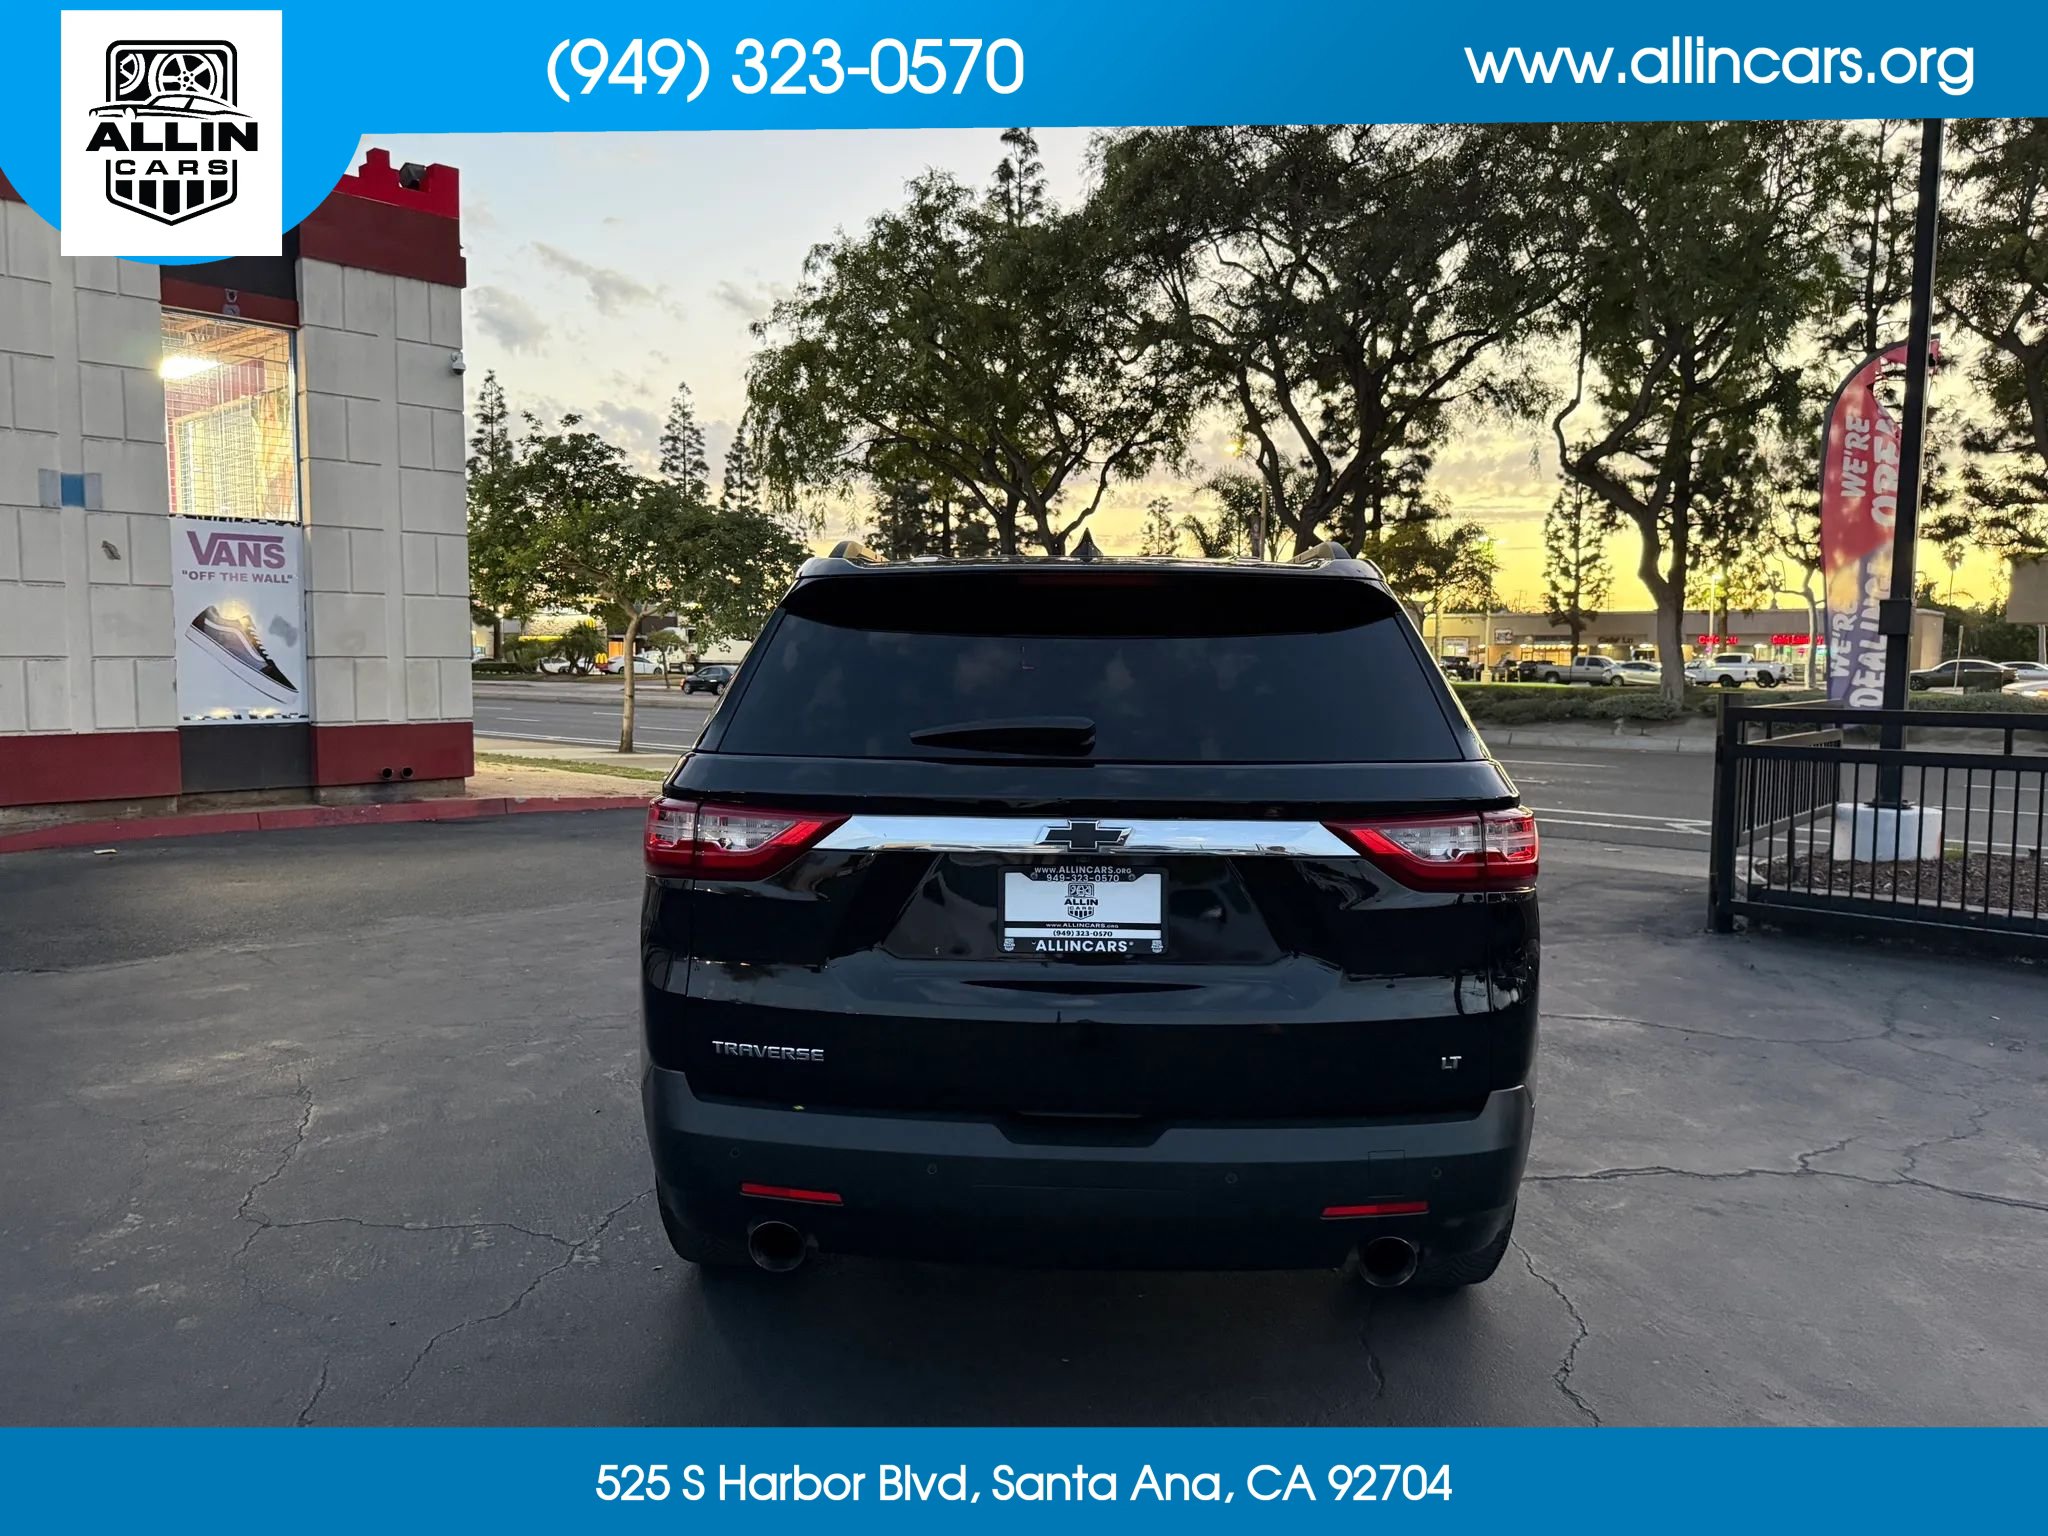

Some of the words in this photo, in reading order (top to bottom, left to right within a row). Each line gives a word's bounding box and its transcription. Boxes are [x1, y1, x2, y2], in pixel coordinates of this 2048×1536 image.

[1841, 415, 1870, 497] WE'RE
[187, 531, 286, 570] VANS
[182, 570, 216, 581] "OFF
[220, 572, 249, 582] THE
[252, 573, 293, 584] WALL"
[1046, 874, 1120, 882] 949-323-0570
[1064, 898, 1099, 906] ALLIN
[1053, 930, 1075, 938] (949)
[1075, 930, 1113, 938] 323-0570
[1035, 940, 1128, 952] ALLINCARS
[712, 1040, 825, 1062] TRAVERSE
[1441, 1055, 1462, 1070] LT
